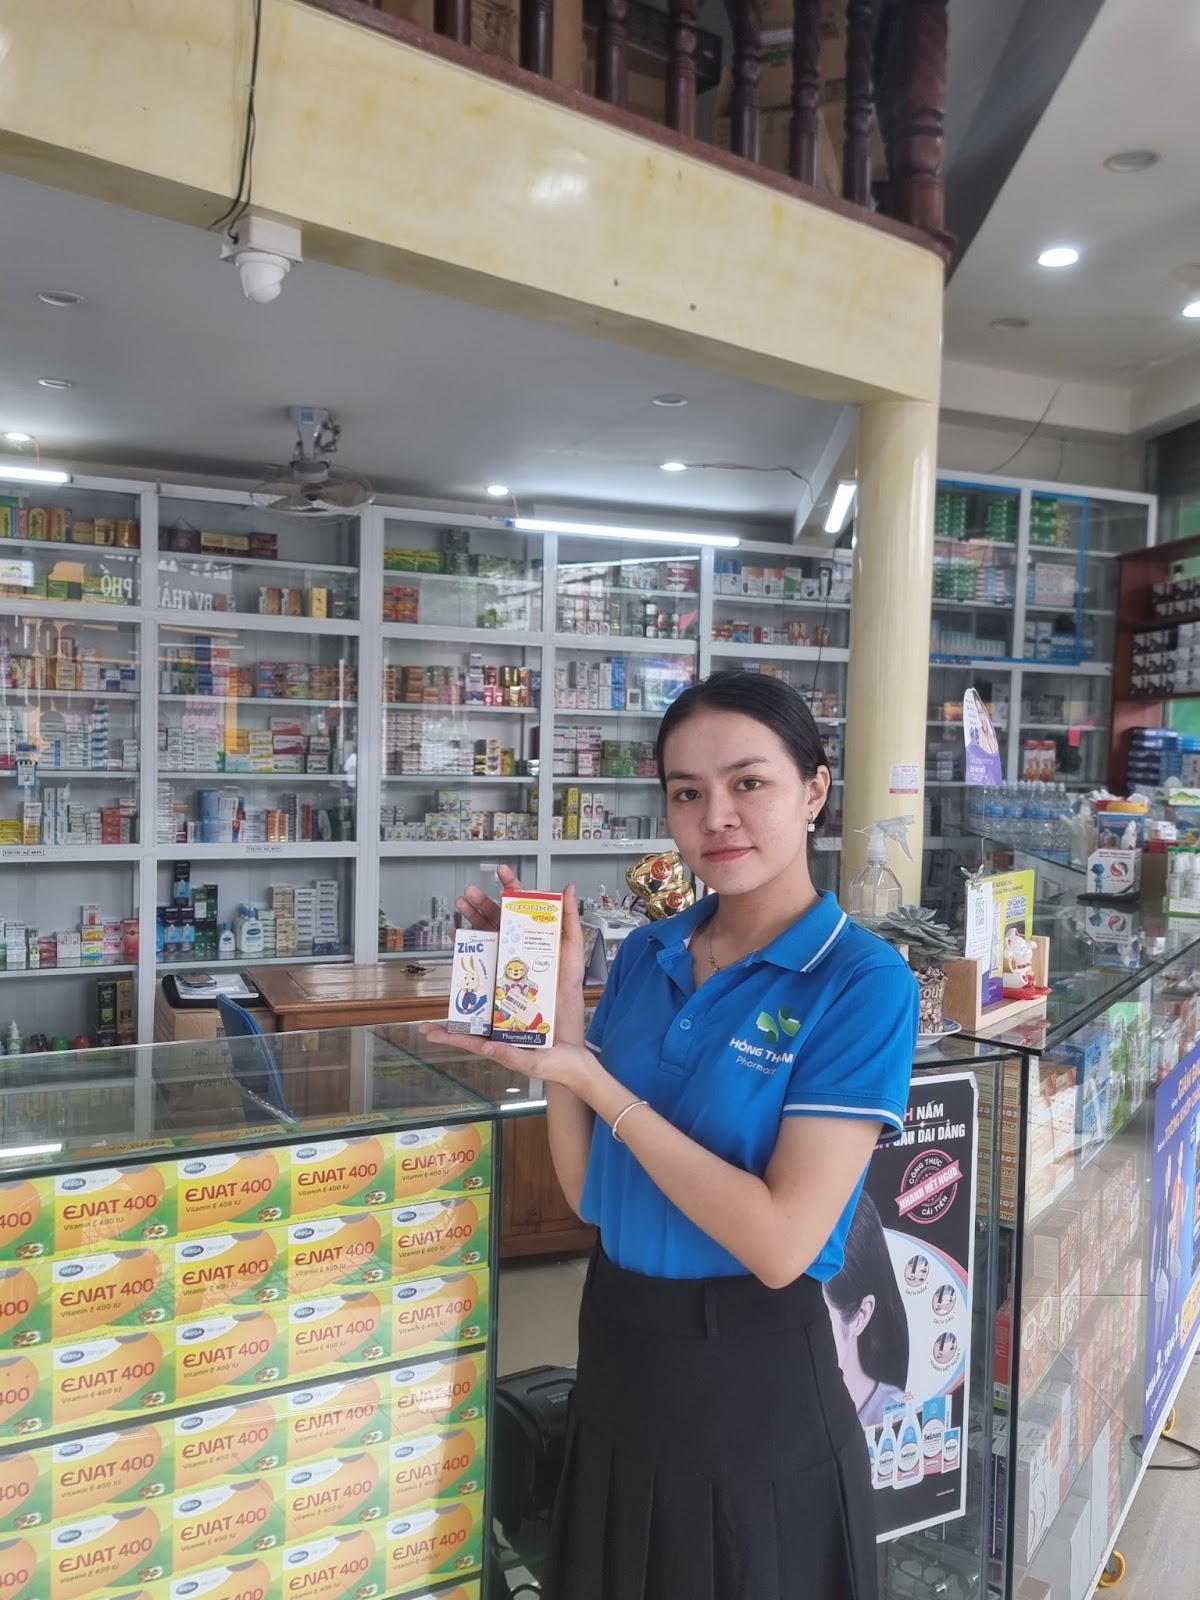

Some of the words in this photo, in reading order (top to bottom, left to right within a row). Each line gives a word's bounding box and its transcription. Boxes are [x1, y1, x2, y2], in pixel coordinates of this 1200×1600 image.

[917, 1100, 944, 1121] NẤM
[918, 1127, 936, 1144] DAI
[401, 1154, 446, 1171] ENAT
[448, 1150, 475, 1163] 400
[298, 1167, 346, 1186] ENAT
[349, 1163, 378, 1178] 400
[402, 1173, 424, 1181] Vitamin
[185, 1183, 238, 1202] ENAT
[241, 1178, 272, 1194] 400
[299, 1188, 322, 1197] Vitamin
[899, 1187, 925, 1210] NHANH
[63, 1200, 120, 1219] ENAT
[124, 1195, 157, 1210] 400
[186, 1203, 211, 1213] Vitamin
[64, 1221, 91, 1231] Vitamin
[398, 1230, 443, 1249] ENAT
[445, 1224, 472, 1238] 400
[295, 1247, 343, 1267] ENAT
[346, 1241, 375, 1256] 400
[182, 1266, 235, 1285] ENAT
[238, 1259, 269, 1275] 400
[60, 1285, 117, 1306] ENAT
[121, 1279, 154, 1296] 400
[398, 1304, 443, 1325] ENAT
[445, 1299, 472, 1314] 400
[295, 1324, 343, 1346] ENAT
[346, 1318, 375, 1335] 400
[183, 1346, 236, 1367] ENAT
[239, 1340, 270, 1357] 400
[61, 1370, 118, 1393] ENAT
[122, 1362, 155, 1379] 400
[295, 1411, 343, 1433] ENAT
[345, 1404, 374, 1421] 400
[182, 1436, 235, 1459] ENAT
[238, 1427, 269, 1445] 400
[924, 1432, 942, 1441] Selsun
[60, 1462, 117, 1487] ENAT
[121, 1454, 154, 1473] 400
[395, 1462, 440, 1485] ENAT
[442, 1455, 469, 1472] 400
[293, 1488, 341, 1512] ENAT
[344, 1480, 373, 1497] 400
[180, 1516, 233, 1540] ENAT
[236, 1508, 267, 1527] 400
[59, 1547, 116, 1572] ENAT
[119, 1538, 152, 1557] 400
[392, 1538, 437, 1561] ENAT
[439, 1529, 466, 1546] 400
[289, 1566, 337, 1592] ENAT
[340, 1557, 369, 1576] 400
